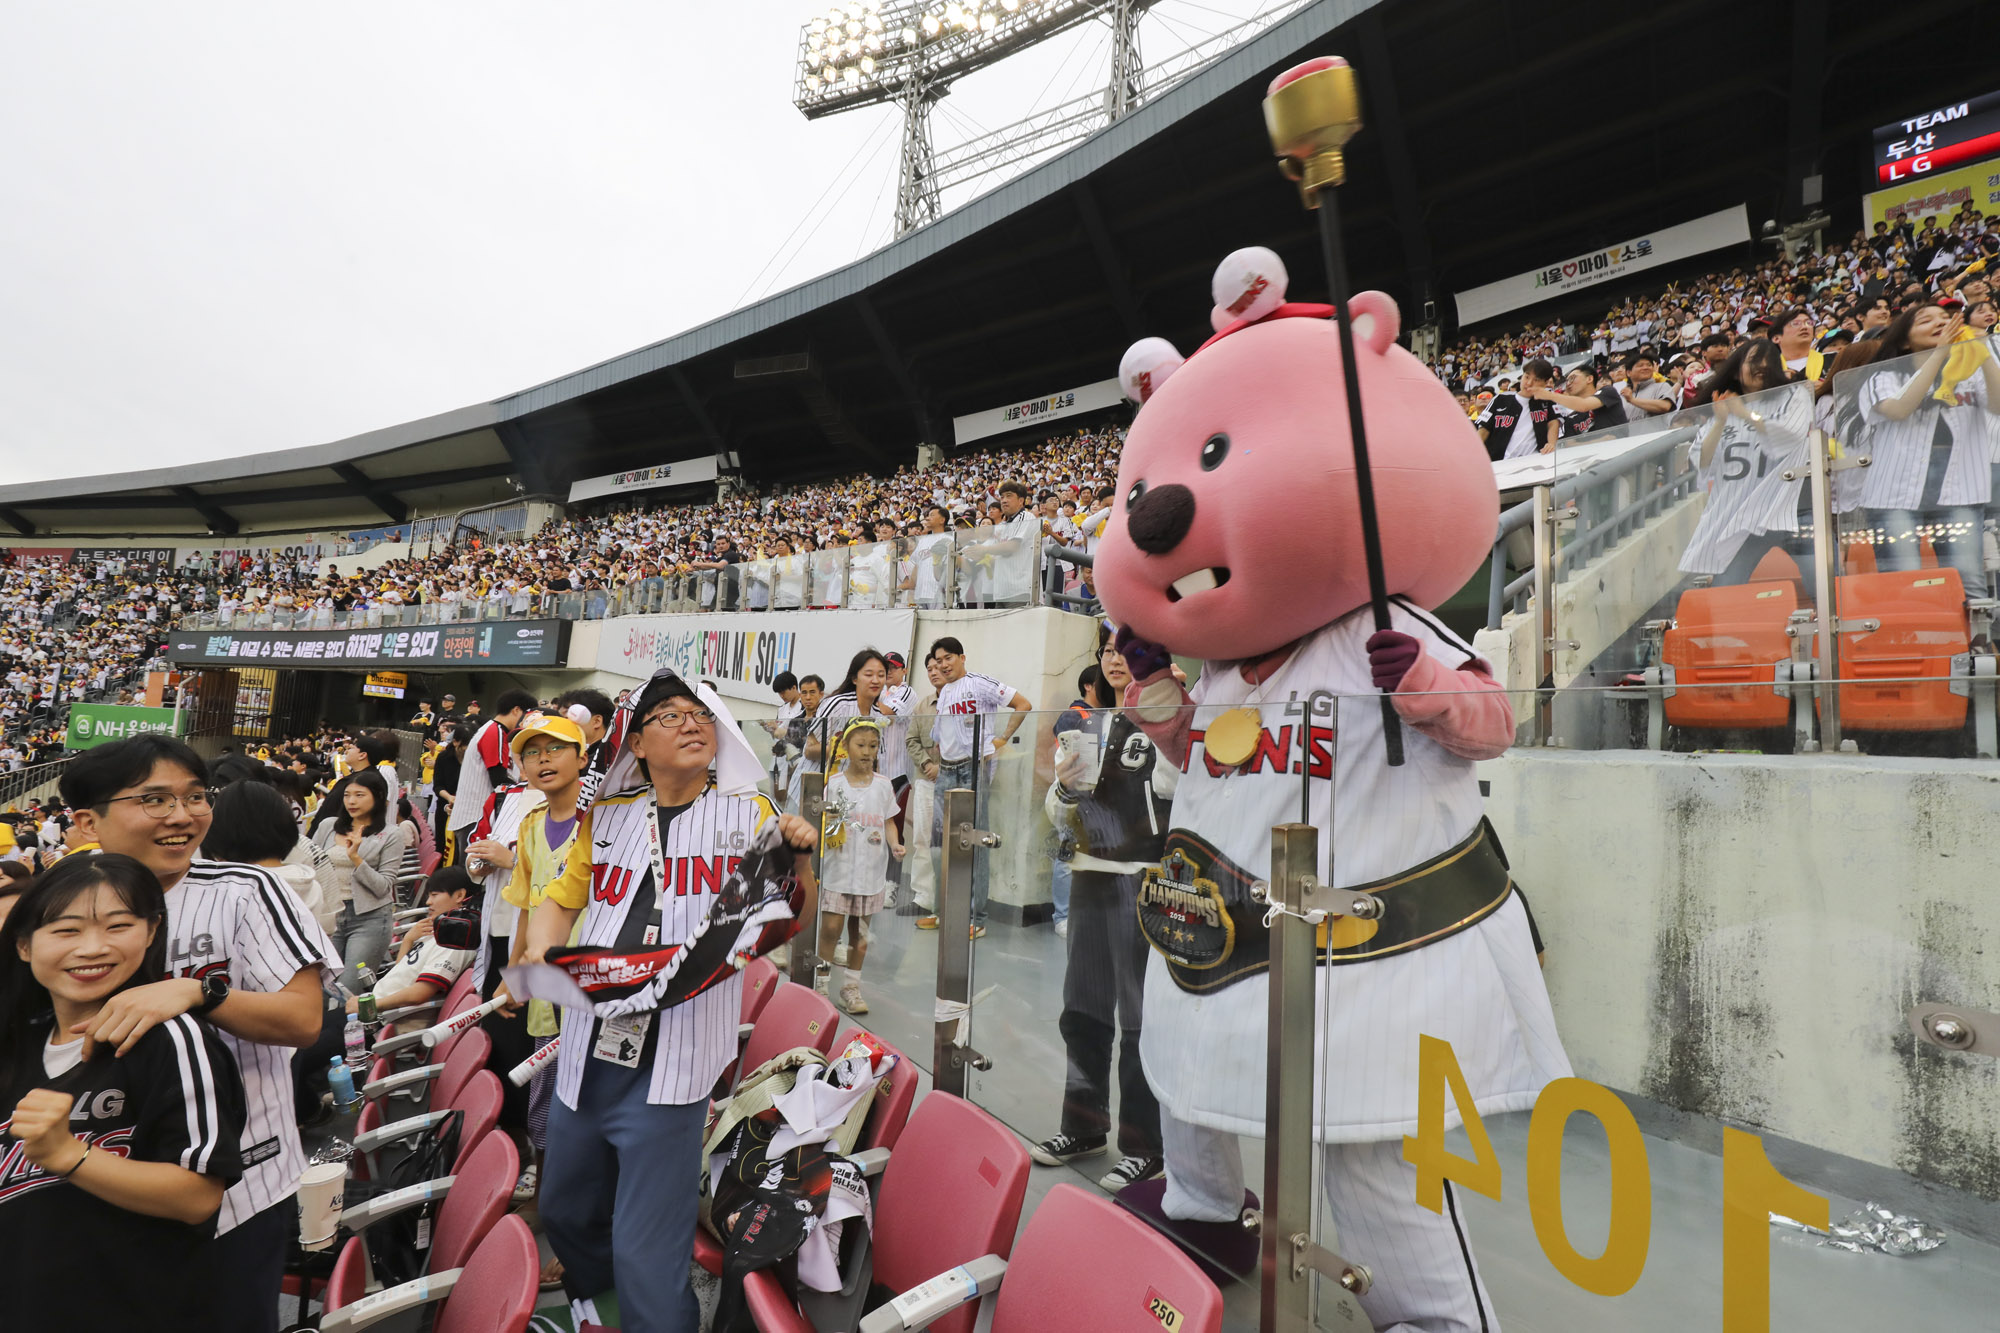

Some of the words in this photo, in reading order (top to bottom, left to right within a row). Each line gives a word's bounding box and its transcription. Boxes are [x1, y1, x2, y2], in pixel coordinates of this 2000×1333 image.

[1901, 102, 1969, 134] TEAM
[1886, 131, 1936, 160] 두산
[1535, 267, 1563, 289] 서울
[1578, 252, 1608, 275] 마이
[1621, 239, 1653, 263] 소울
[1003, 406, 1021, 422] 서울
[1030, 399, 1048, 416] 마이
[1056, 392, 1075, 409] 소울
[610, 474, 626, 486] 서울
[634, 469, 650, 483] 마이
[655, 466, 671, 479] 소울
[127, 551, 170, 563] 디데이
[205, 635, 240, 657] 불안을
[240, 640, 261, 657] 이길
[260, 640, 271, 658] 수
[271, 641, 293, 658] 있는
[293, 641, 325, 659] 사람은
[324, 640, 346, 658] 없다
[345, 633, 382, 659] 하지만
[381, 632, 410, 658] 약은
[408, 630, 439, 658] 있다
[443, 636, 476, 659] 안정액
[1284, 690, 1334, 717] LG
[649, 823, 657, 844] TWINS
[716, 830, 745, 849] LG
[1157, 878, 1178, 889] KOREAN
[1178, 882, 1197, 893] SERIES
[1140, 880, 1220, 928] CHAMPIONS
[170, 933, 215, 962] LG
[448, 1009, 482, 1033] TWINS
[68, 1088, 126, 1121] LG
[742, 1203, 772, 1244] TWINS
[1151, 1298, 1175, 1327] 250
